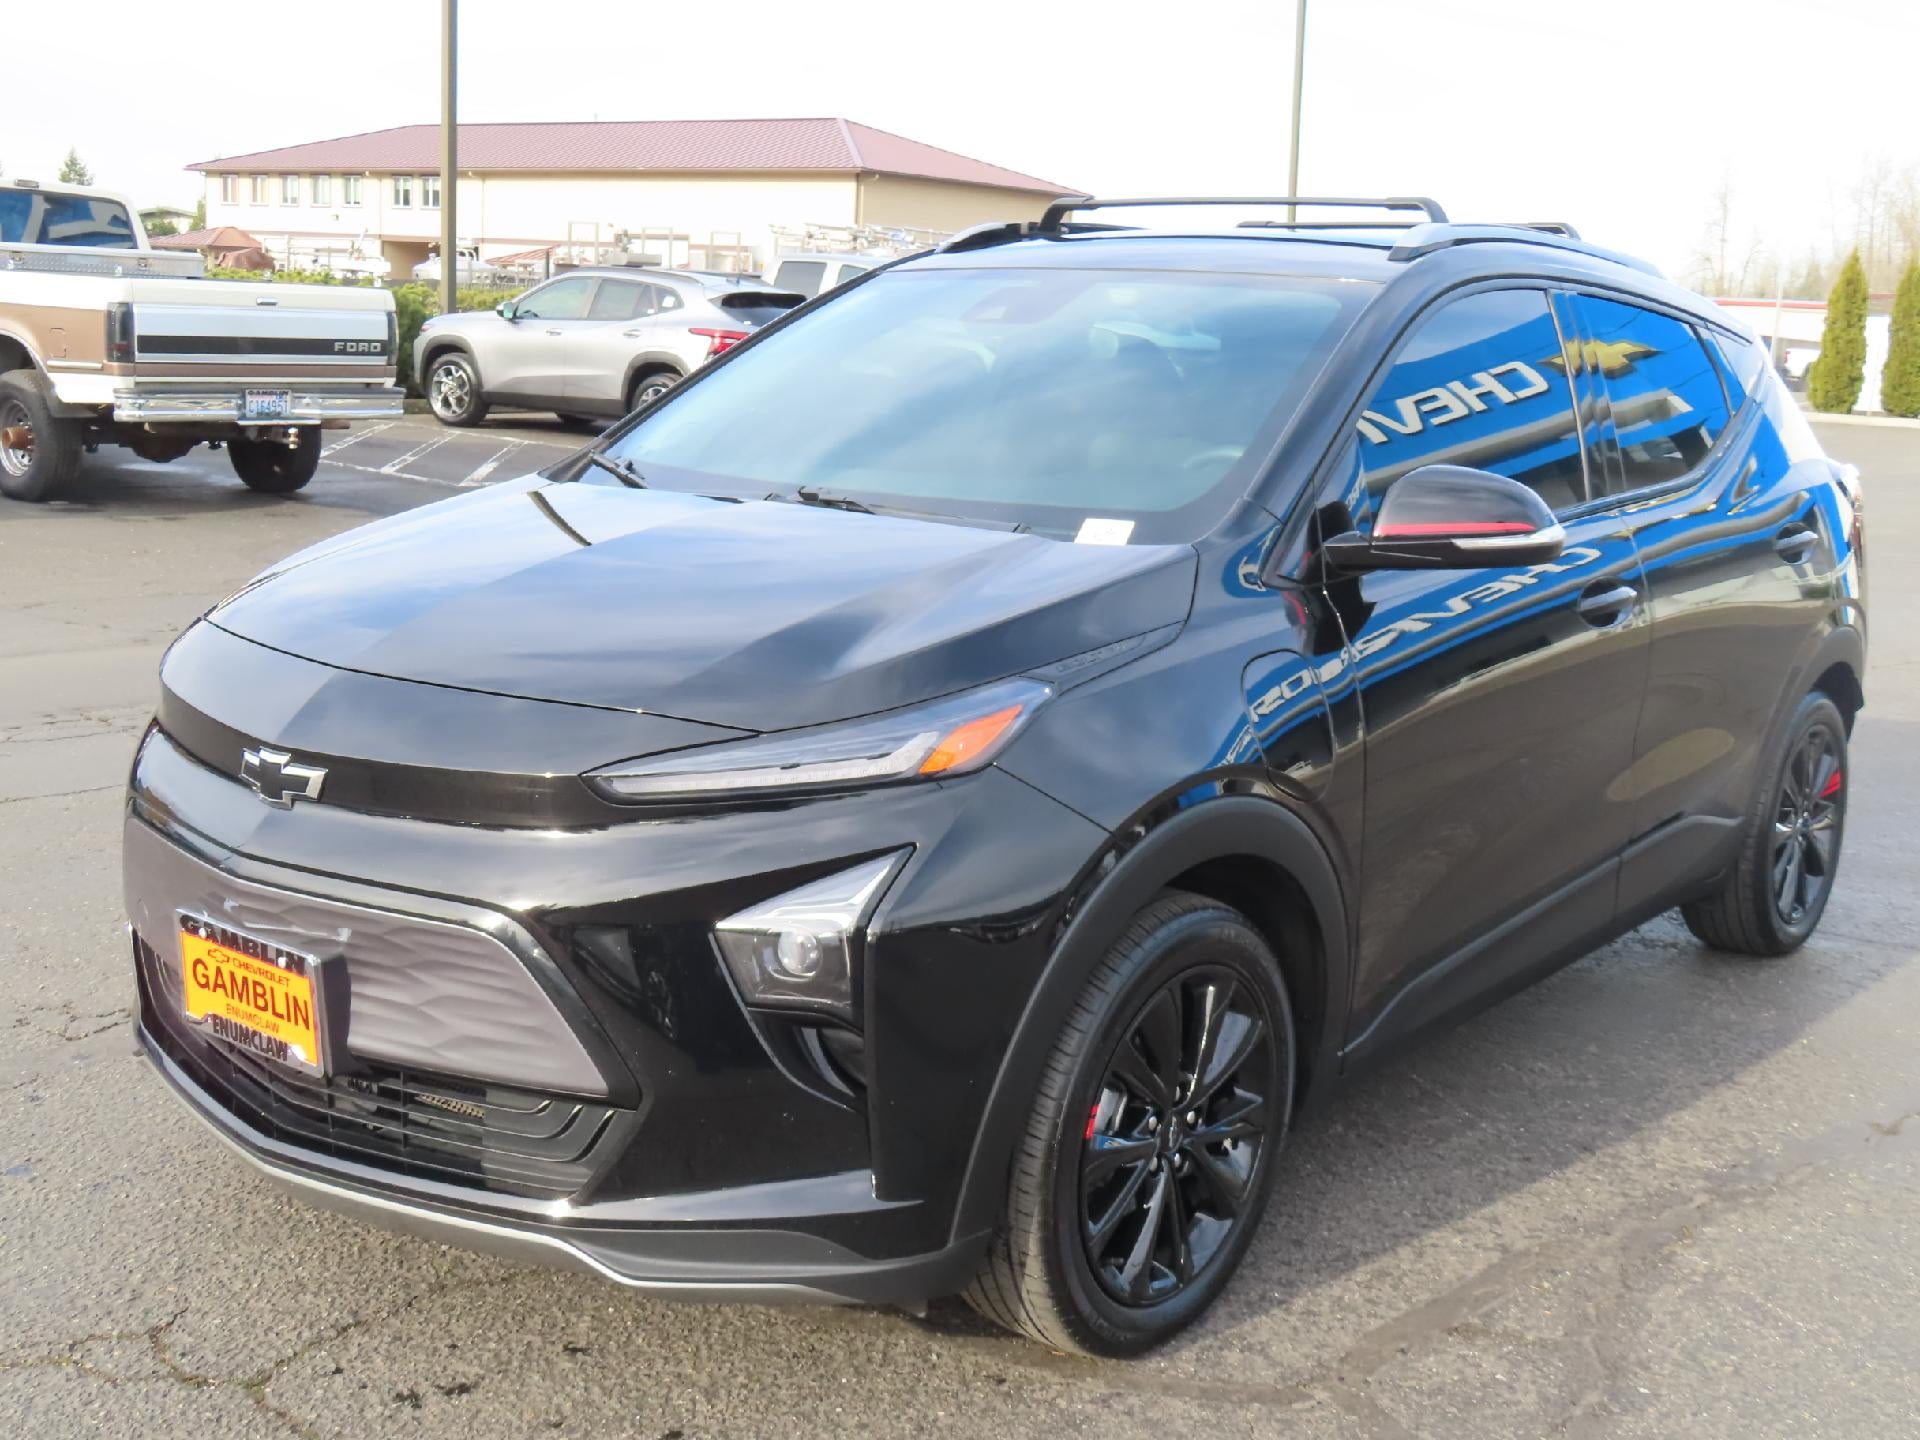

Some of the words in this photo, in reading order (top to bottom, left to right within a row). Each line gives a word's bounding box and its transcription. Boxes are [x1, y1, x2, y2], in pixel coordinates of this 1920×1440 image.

[334, 341, 381, 352] FORD
[180, 915, 305, 976] GAMBLIN
[232, 957, 291, 987] CHEVROLET
[192, 958, 310, 1030] GAMBLIN
[226, 1003, 280, 1033] ENUMCLAW
[212, 1014, 288, 1062] ENUMCLAW
